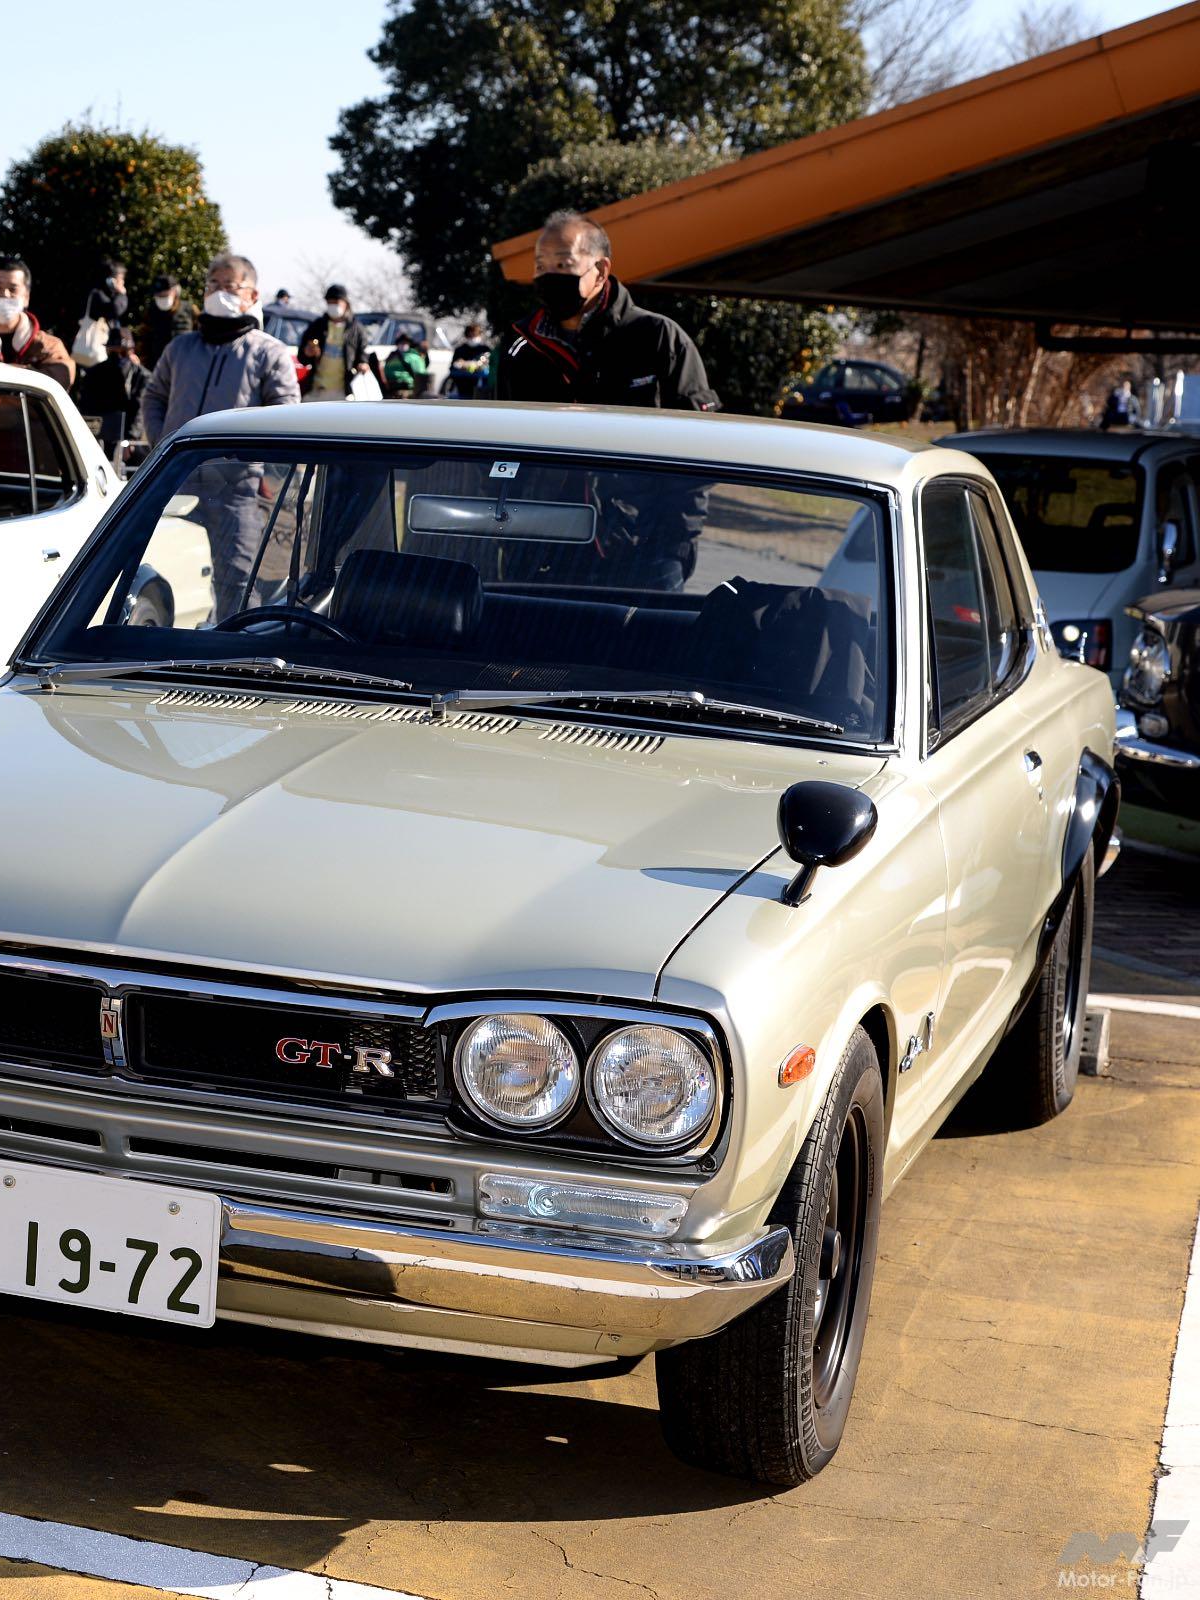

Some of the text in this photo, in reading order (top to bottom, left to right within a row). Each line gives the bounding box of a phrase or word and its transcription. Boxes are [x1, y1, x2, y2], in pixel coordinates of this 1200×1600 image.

[497, 463, 507, 473] 6
[103, 1014, 115, 1034] N
[275, 1037, 395, 1077] GT-R
[24, 1221, 203, 1315] 19-72
